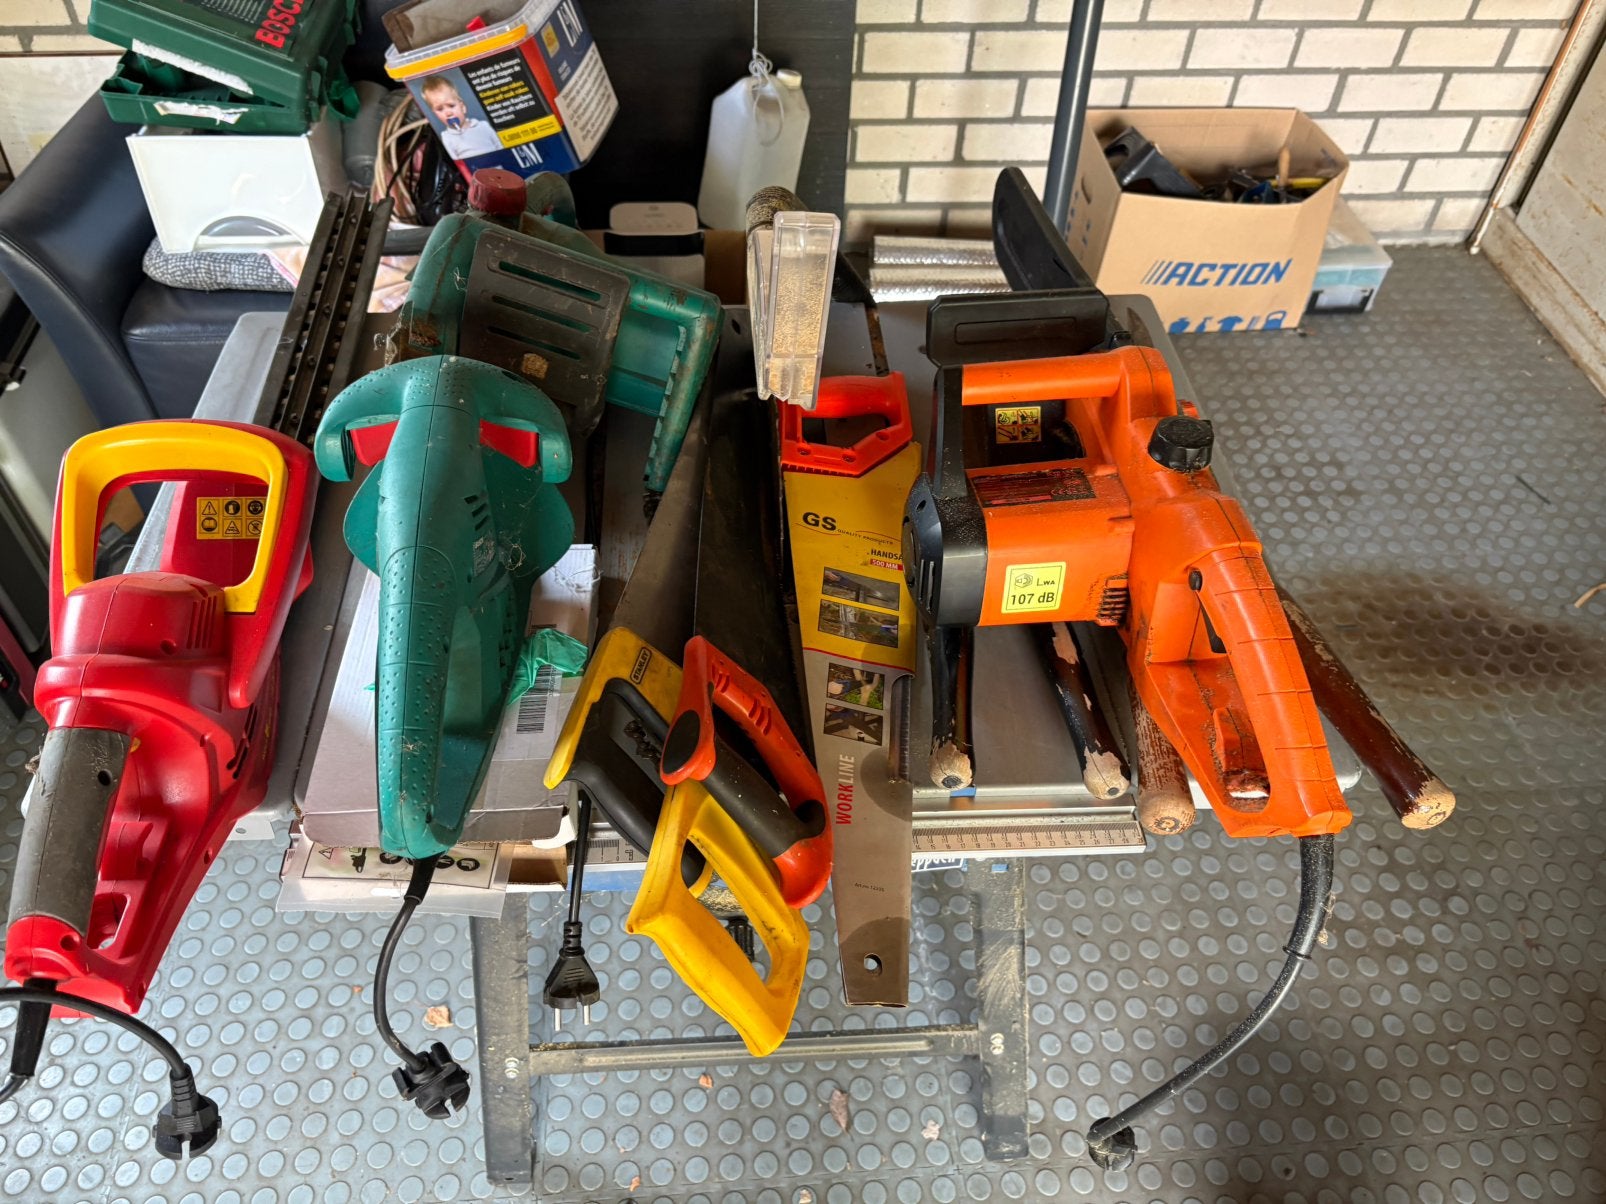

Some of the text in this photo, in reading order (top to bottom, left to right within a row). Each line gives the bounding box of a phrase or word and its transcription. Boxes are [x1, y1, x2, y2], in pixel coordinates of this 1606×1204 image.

[255, 0, 304, 49] BOSC
[1164, 258, 1292, 287] ACTION
[802, 511, 837, 532] GS
[837, 528, 894, 546] QUALITY PRODUCTS
[870, 548, 903, 561] HANDSA
[872, 559, 885, 568] 500
[1010, 590, 1055, 606] 107 dB
[632, 650, 649, 681] STANLEY
